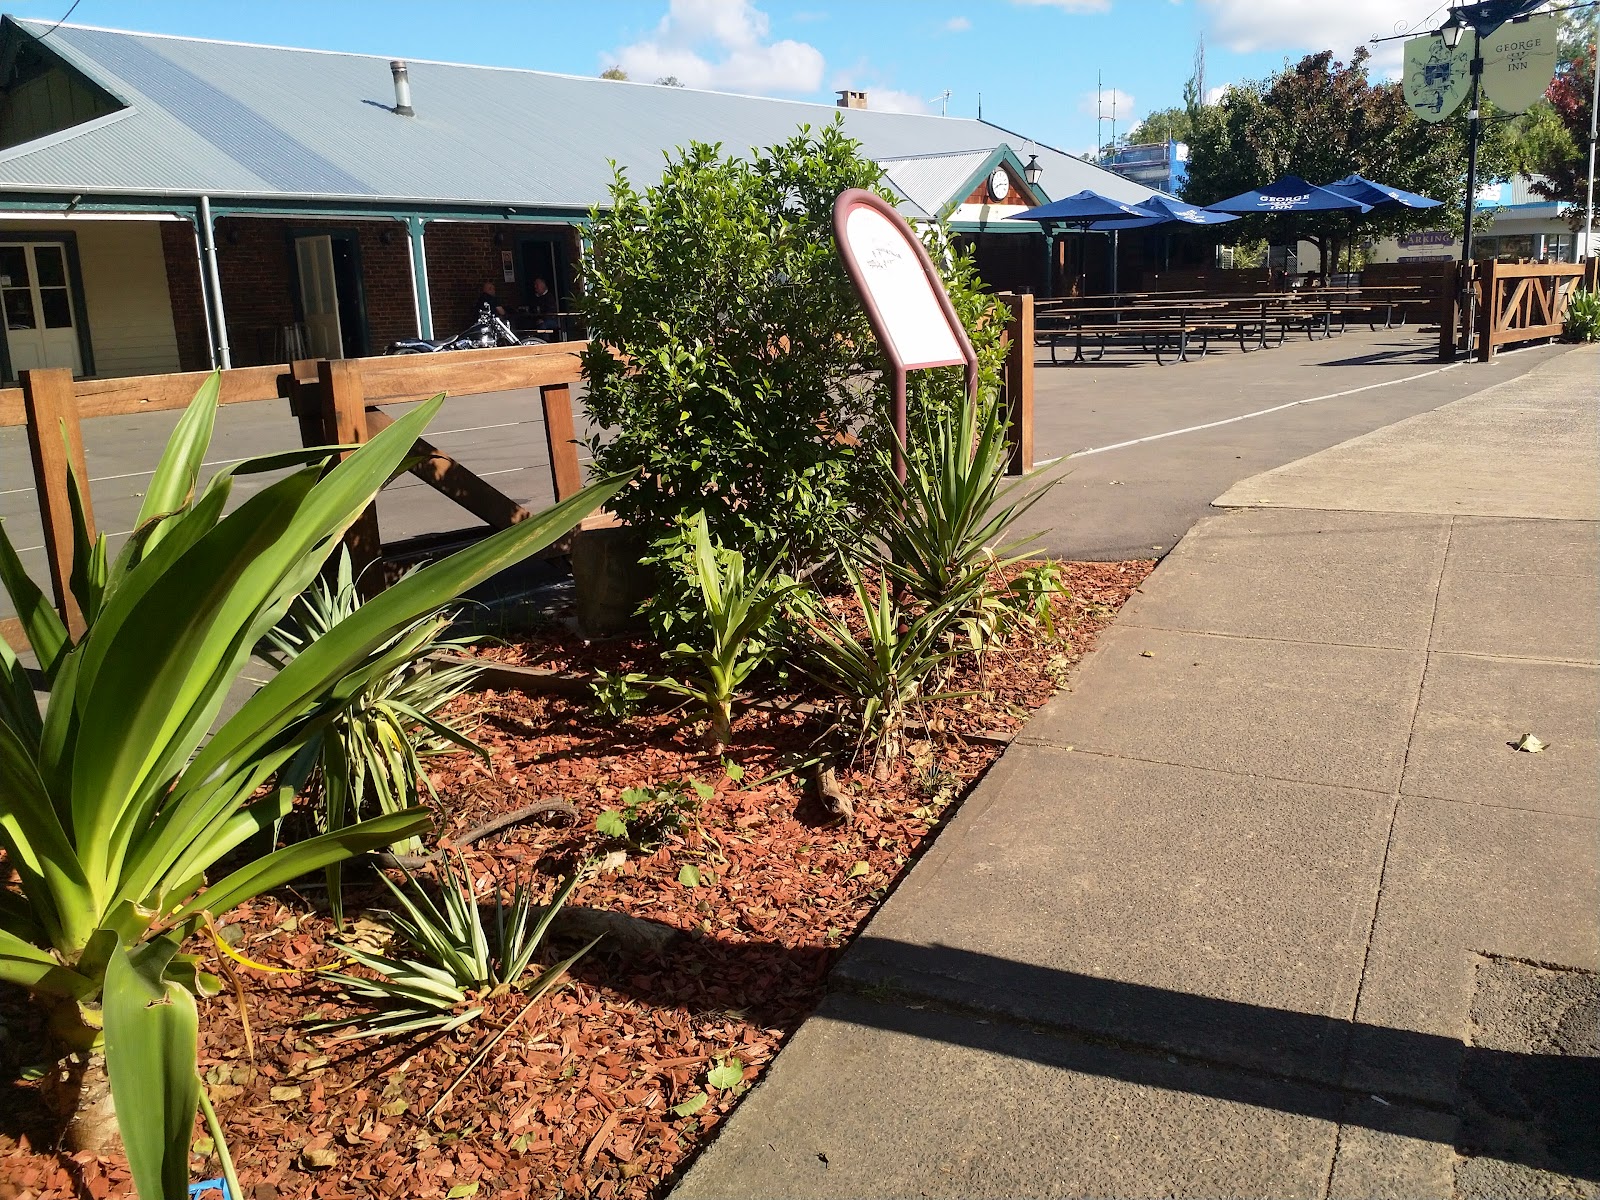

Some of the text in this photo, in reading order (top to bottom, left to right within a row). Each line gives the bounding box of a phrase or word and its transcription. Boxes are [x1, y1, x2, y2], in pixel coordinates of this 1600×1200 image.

[1495, 38, 1541, 52] GEORGE
[1508, 62, 1528, 71] INN
[1260, 194, 1310, 202] GEORGE
[1402, 235, 1449, 243] ARKING
